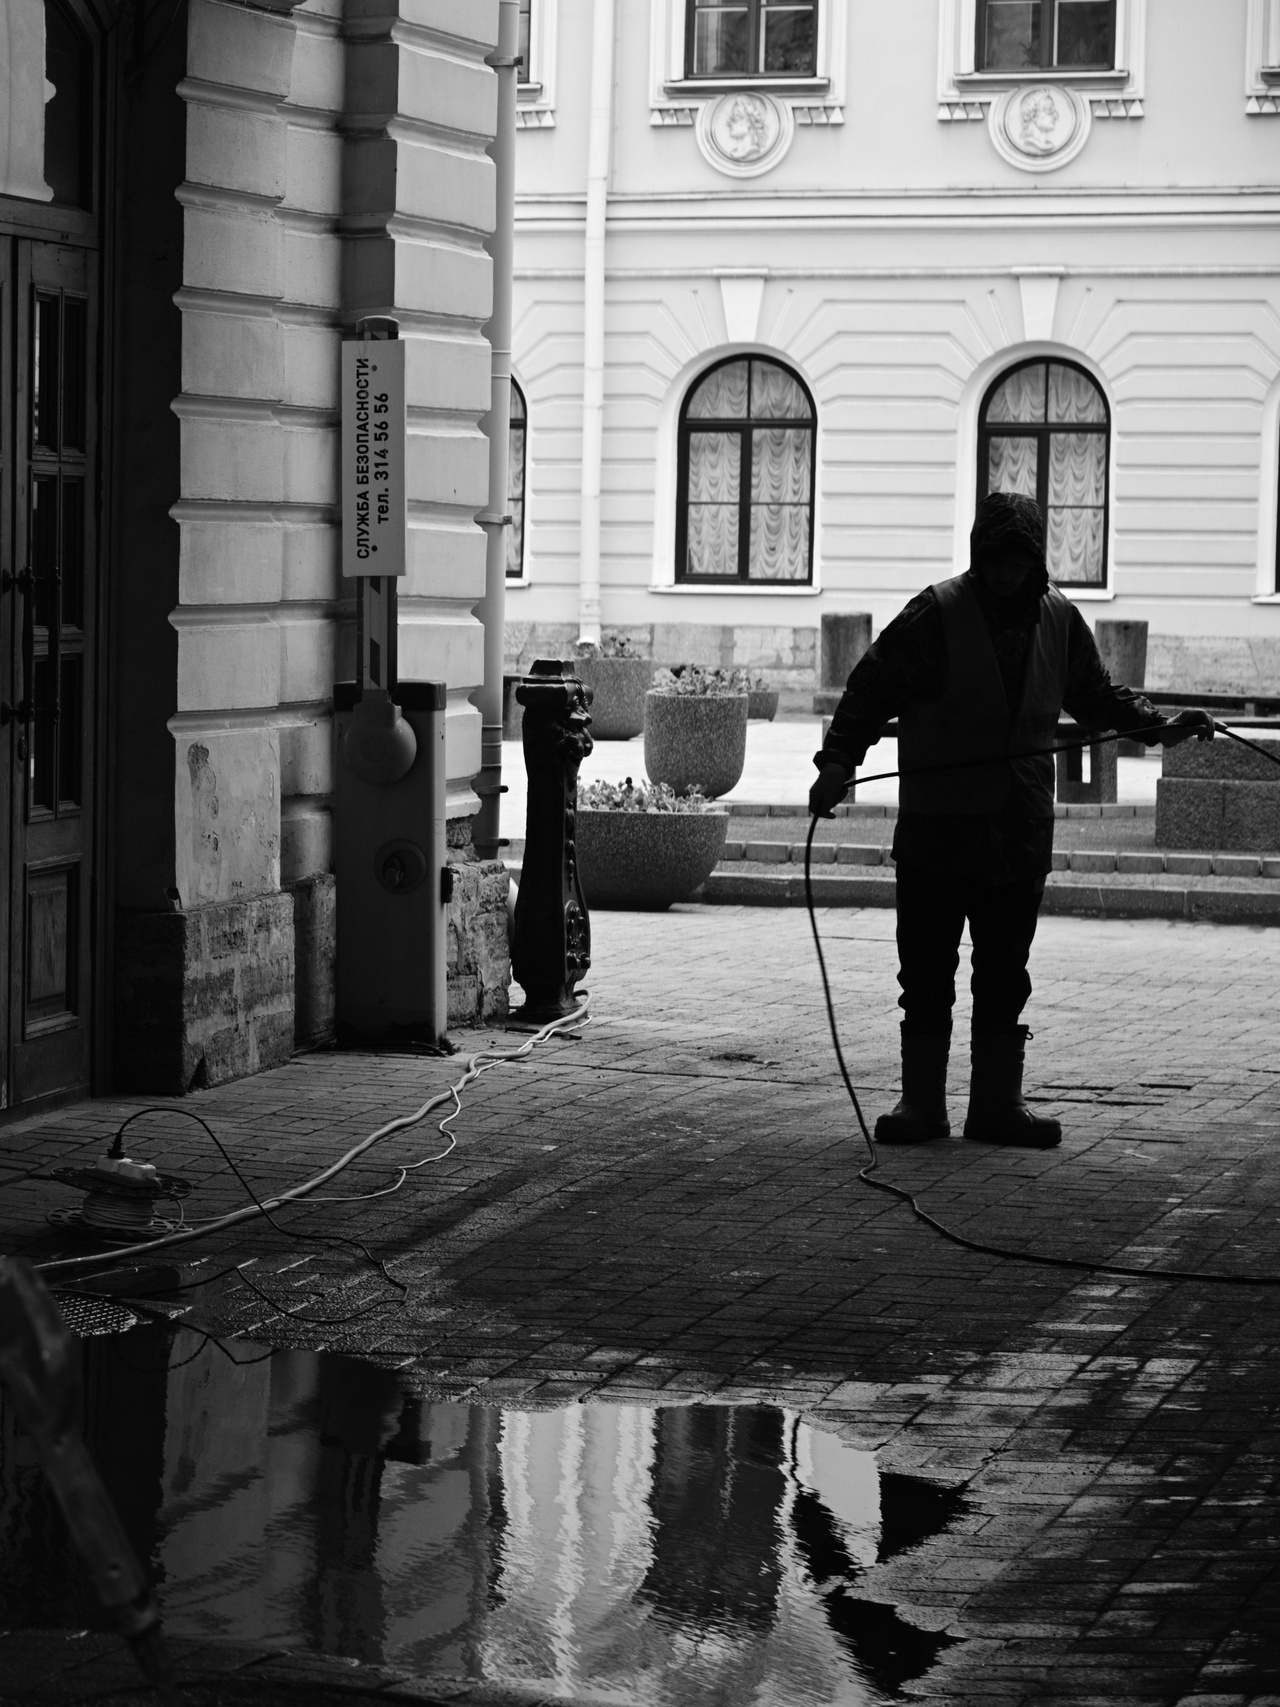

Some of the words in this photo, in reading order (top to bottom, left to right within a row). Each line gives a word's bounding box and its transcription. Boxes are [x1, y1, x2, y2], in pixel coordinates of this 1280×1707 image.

[374, 392, 389, 414] 56
[356, 358, 369, 485] БЕЗОПАСНОСТИ
[374, 420, 389, 442] 56
[374, 448, 389, 481] 314
[377, 487, 389, 525] тел.
[356, 490, 370, 559] СЛУЖБА
